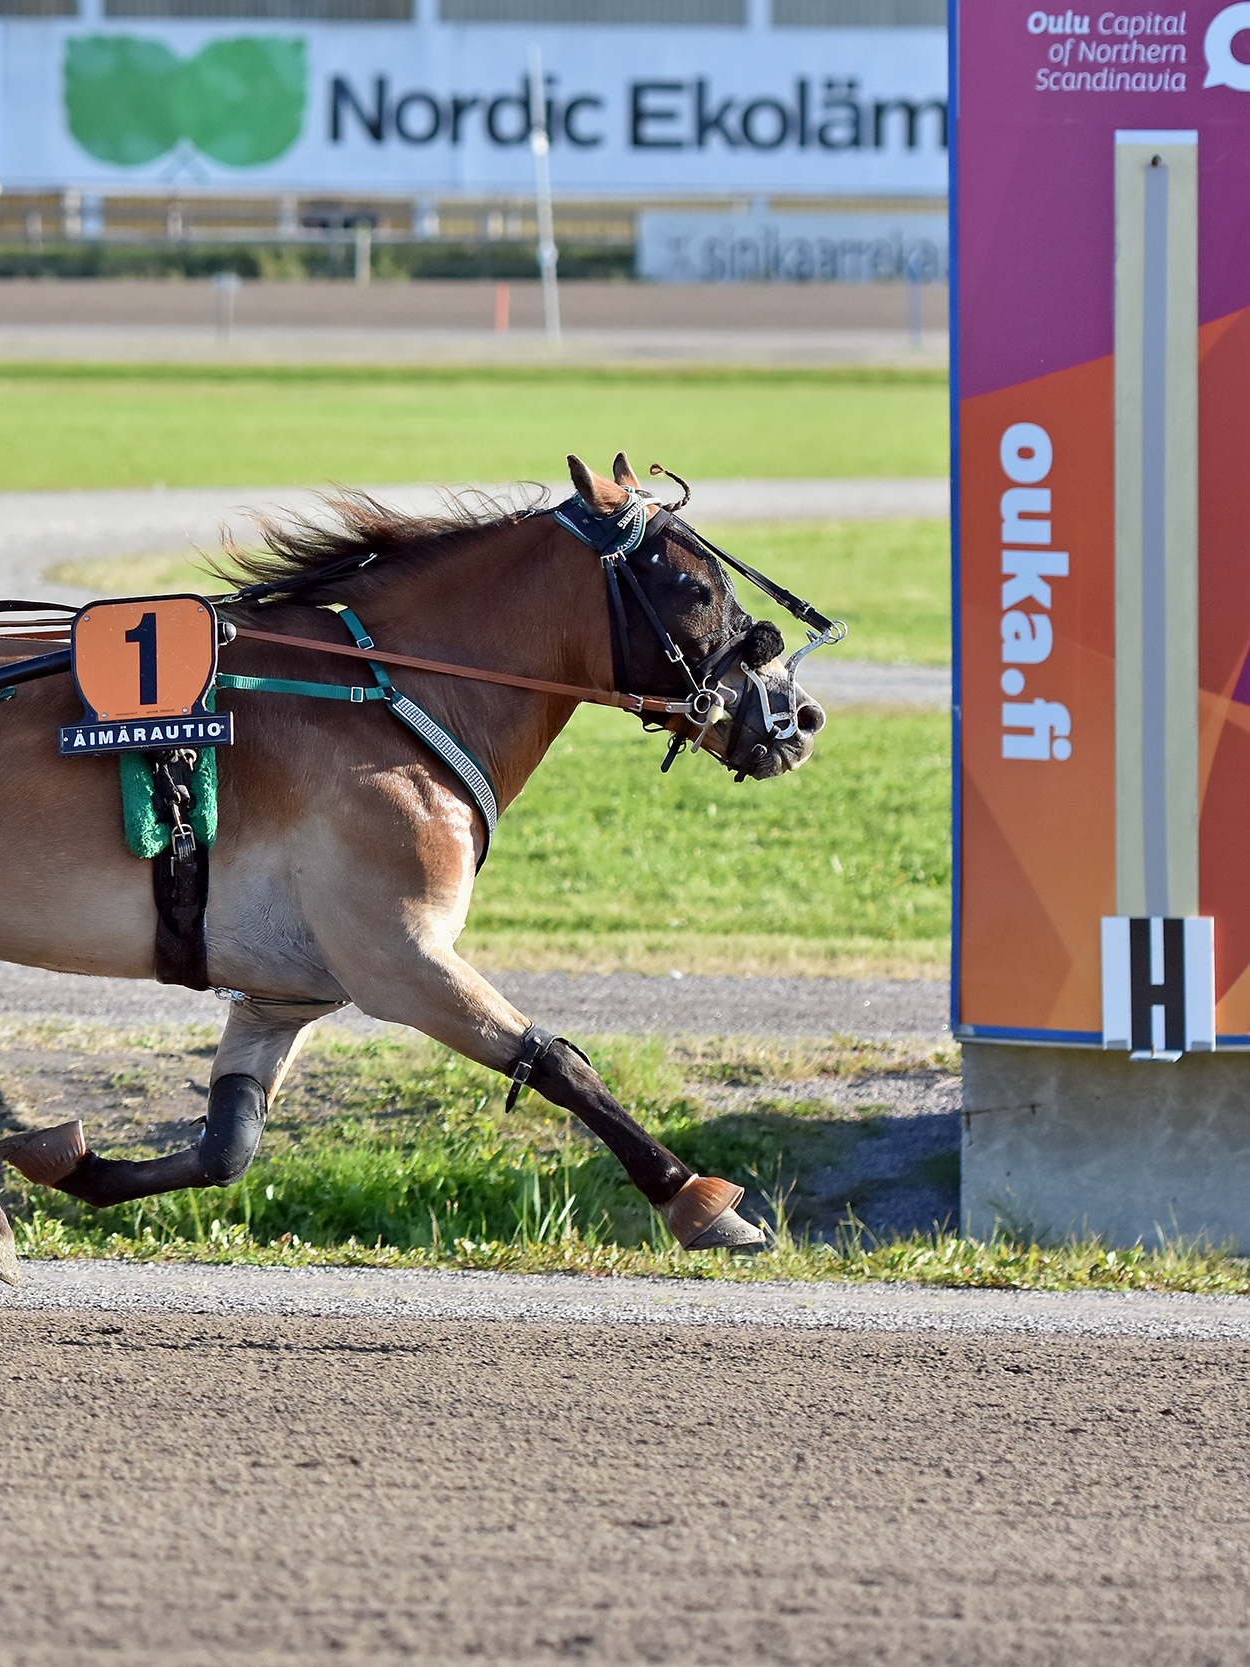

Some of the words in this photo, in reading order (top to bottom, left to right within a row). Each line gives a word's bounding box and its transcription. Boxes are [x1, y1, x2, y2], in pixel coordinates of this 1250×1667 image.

[1027, 9, 1090, 35] Oulu
[1097, 11, 1187, 40] Capital
[1048, 38, 1076, 68] of
[1077, 39, 1187, 64] Northern
[1035, 66, 1187, 92] Scandinavia
[327, 74, 604, 147] Nordic
[1000, 422, 1072, 762] ouka.fi
[125, 612, 158, 706] 1
[73, 722, 222, 748] ÄIMÄRAUTIO
